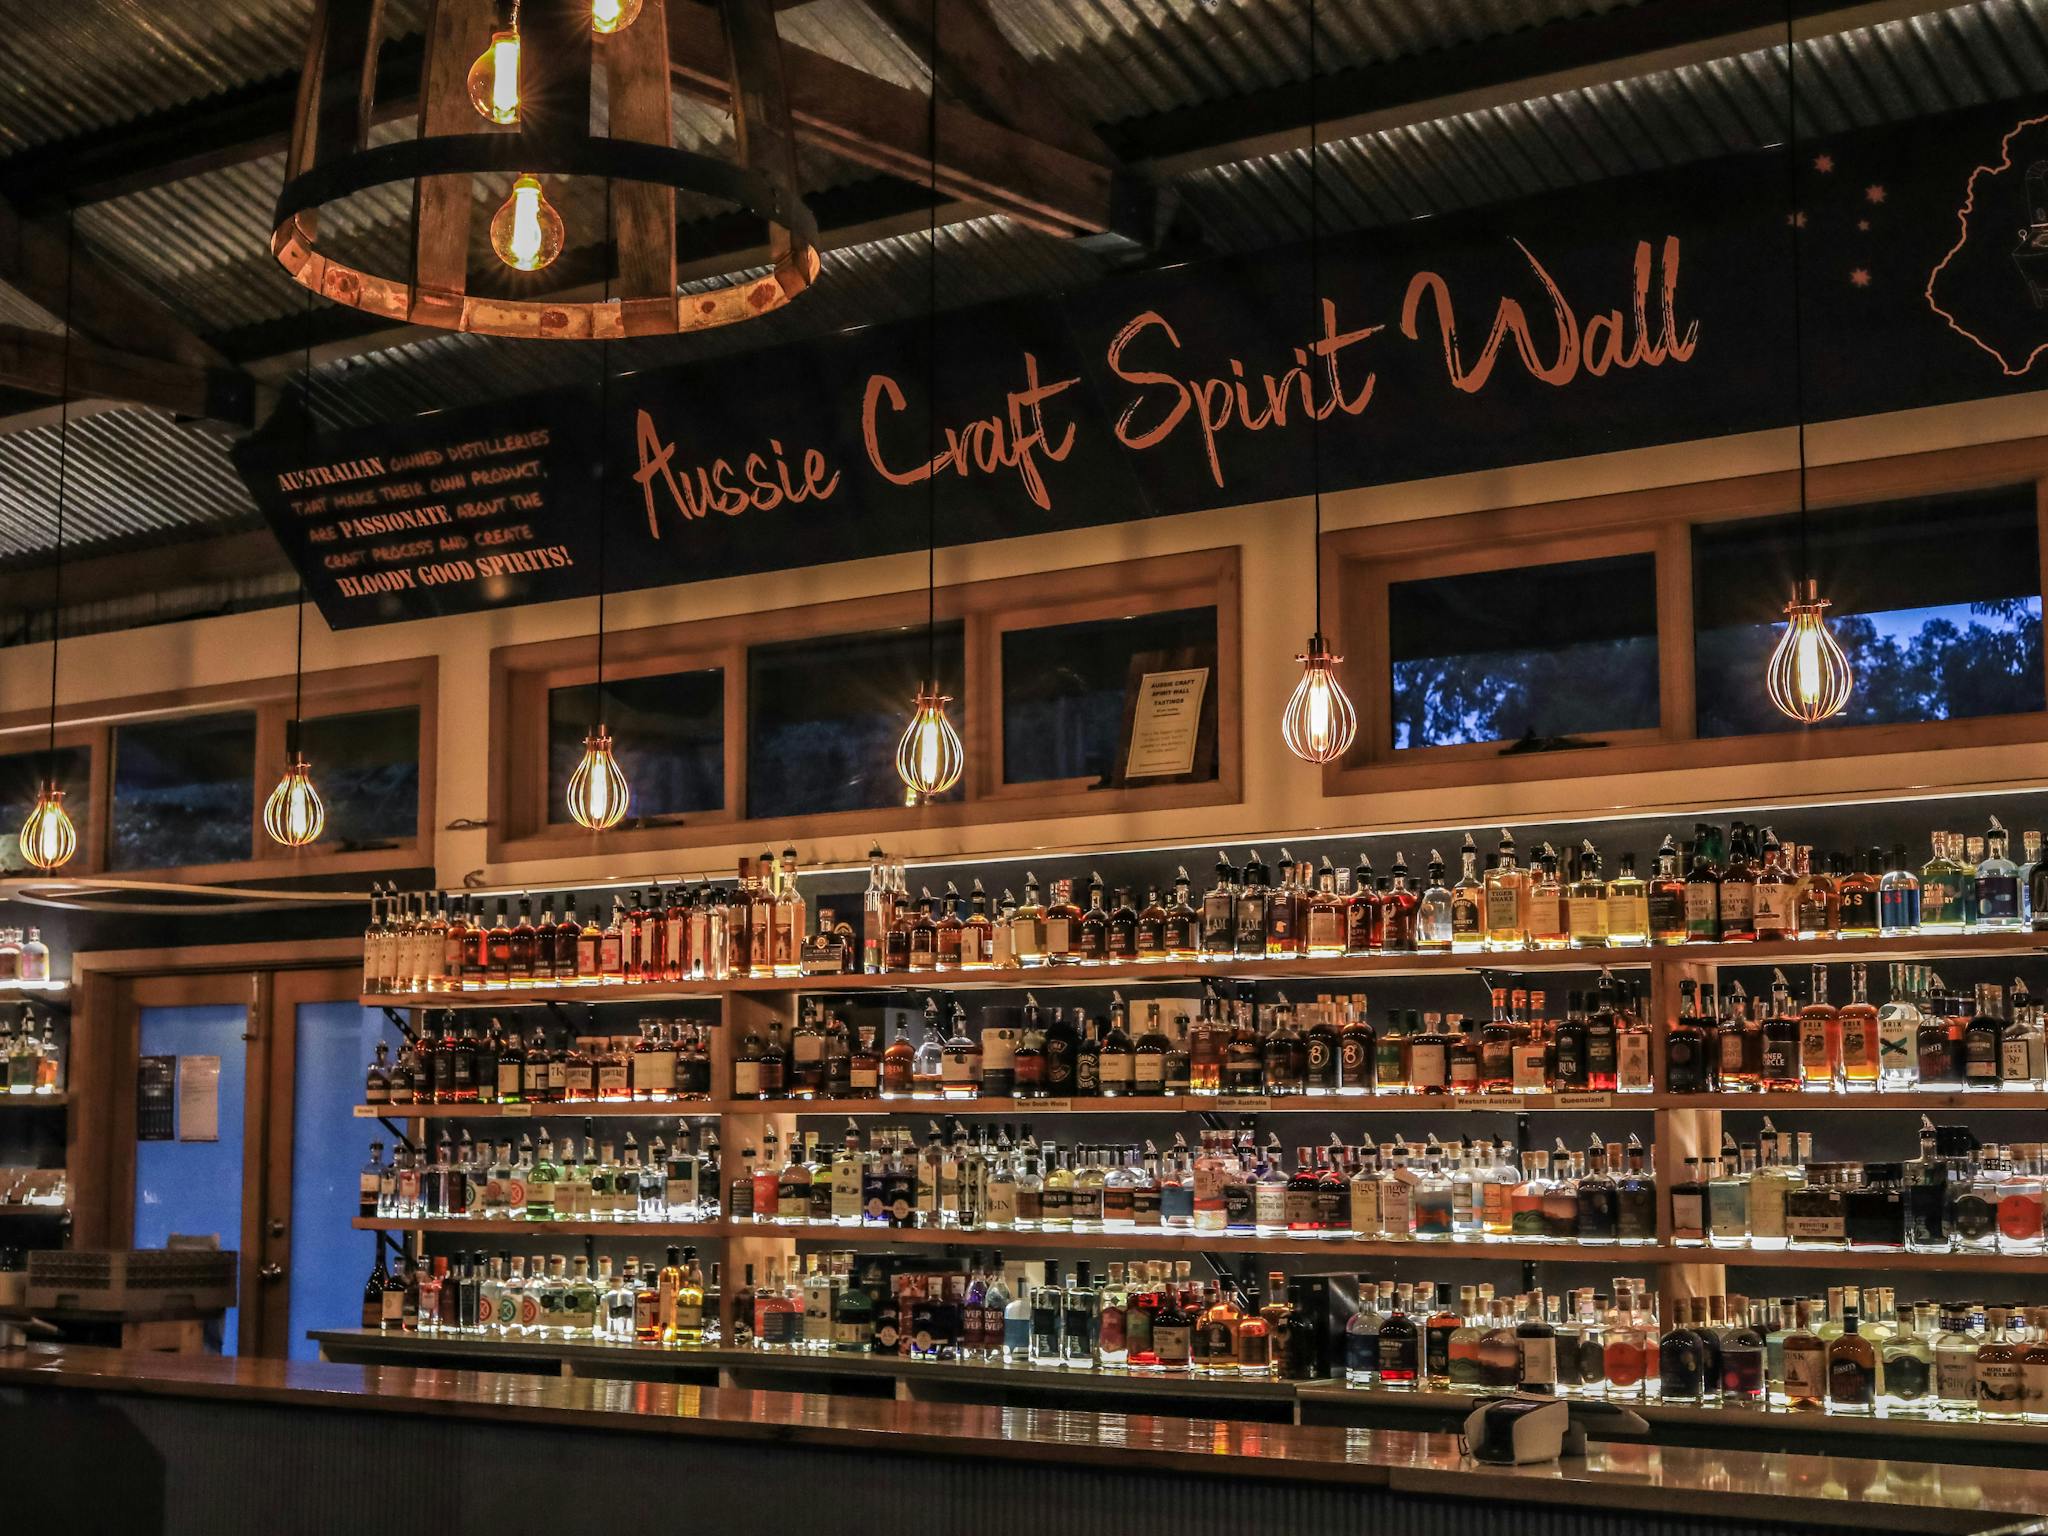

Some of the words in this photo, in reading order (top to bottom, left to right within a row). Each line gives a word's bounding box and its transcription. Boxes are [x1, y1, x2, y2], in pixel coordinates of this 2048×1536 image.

[633, 409, 840, 538] Aussie
[862, 352, 1081, 510] Craft
[1107, 298, 1386, 489] Spirit
[1400, 235, 1699, 394] Wall
[277, 456, 386, 492] AUSTRALIAN
[390, 450, 444, 472] OWNED
[446, 429, 551, 462] DISTILLERIES
[292, 499, 327, 515] THAT
[334, 491, 377, 509] MAKE
[380, 482, 425, 502] THEIR
[430, 477, 466, 495] OWN
[471, 460, 549, 486] PRODUCT,
[309, 526, 338, 543] ARE
[339, 505, 452, 539] PASSIONATE
[457, 498, 506, 519] ABOUT
[511, 491, 543, 510] THE
[324, 551, 370, 569] CRAFT
[372, 540, 436, 563] PROCESS
[440, 536, 469, 551] AND
[474, 523, 534, 547] CREATE
[336, 568, 417, 599] BLOODY
[418, 559, 477, 586] GOOD
[480, 545, 575, 578] SPIRITS!
[1175, 679, 1195, 687] CRAFT
[1558, 1061, 1577, 1075] RUM
[1560, 1096, 1604, 1104] Queensland
[992, 1200, 1009, 1209] GIN
